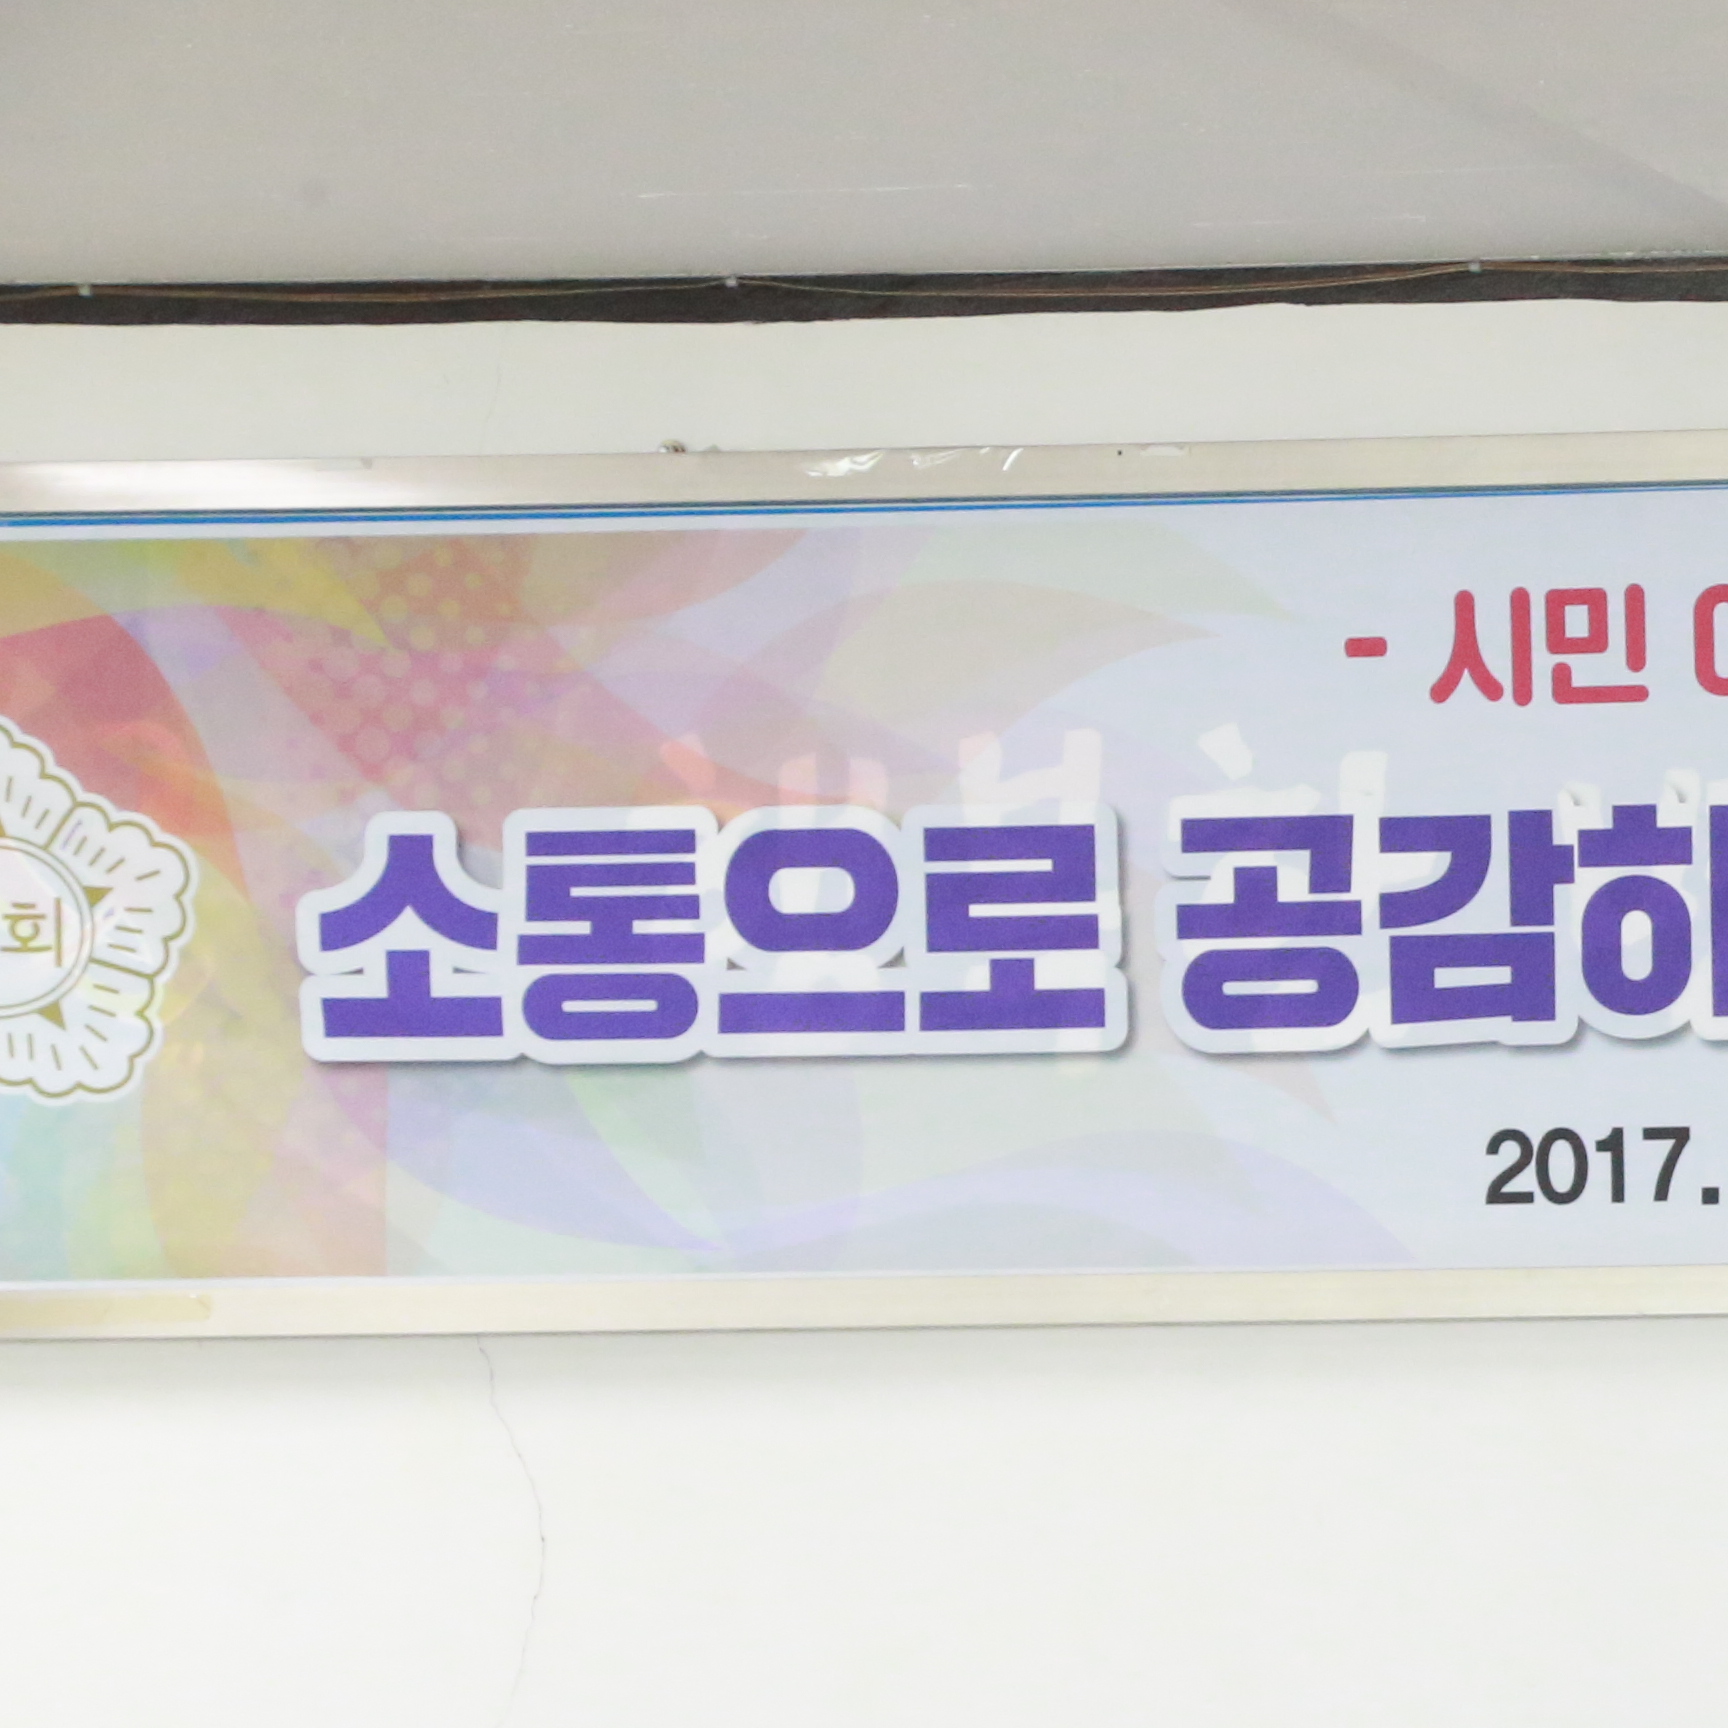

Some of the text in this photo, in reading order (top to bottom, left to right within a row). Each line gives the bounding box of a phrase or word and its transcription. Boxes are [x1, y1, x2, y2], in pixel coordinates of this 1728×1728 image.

[1430, 584, 1650, 707] 시민
[319, 826, 1107, 1041] 소통으로
[1486, 1126, 1721, 1206] 2017.
